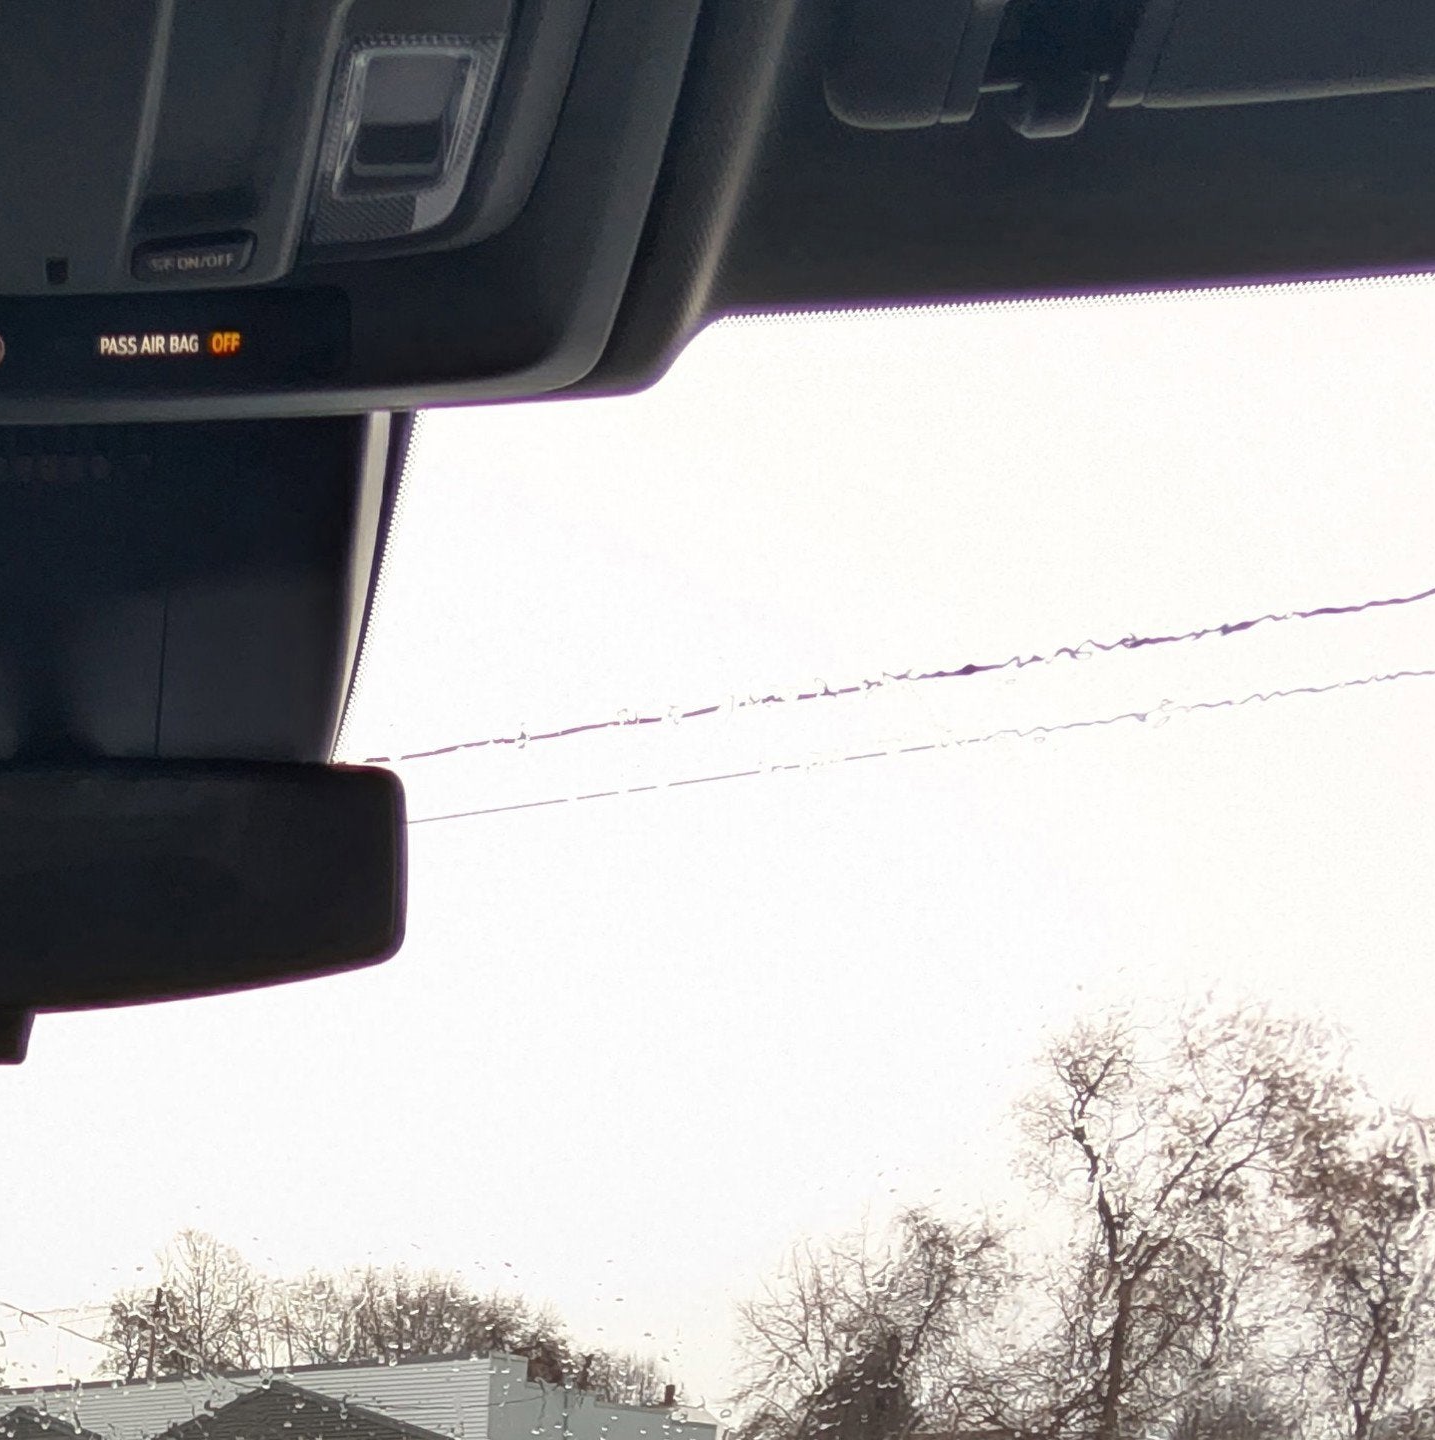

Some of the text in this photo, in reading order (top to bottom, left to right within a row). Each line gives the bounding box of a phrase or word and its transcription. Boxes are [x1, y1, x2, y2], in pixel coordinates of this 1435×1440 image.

[177, 253, 233, 270] ON/OFF
[100, 332, 241, 354] PASS AIR BAG OFF
